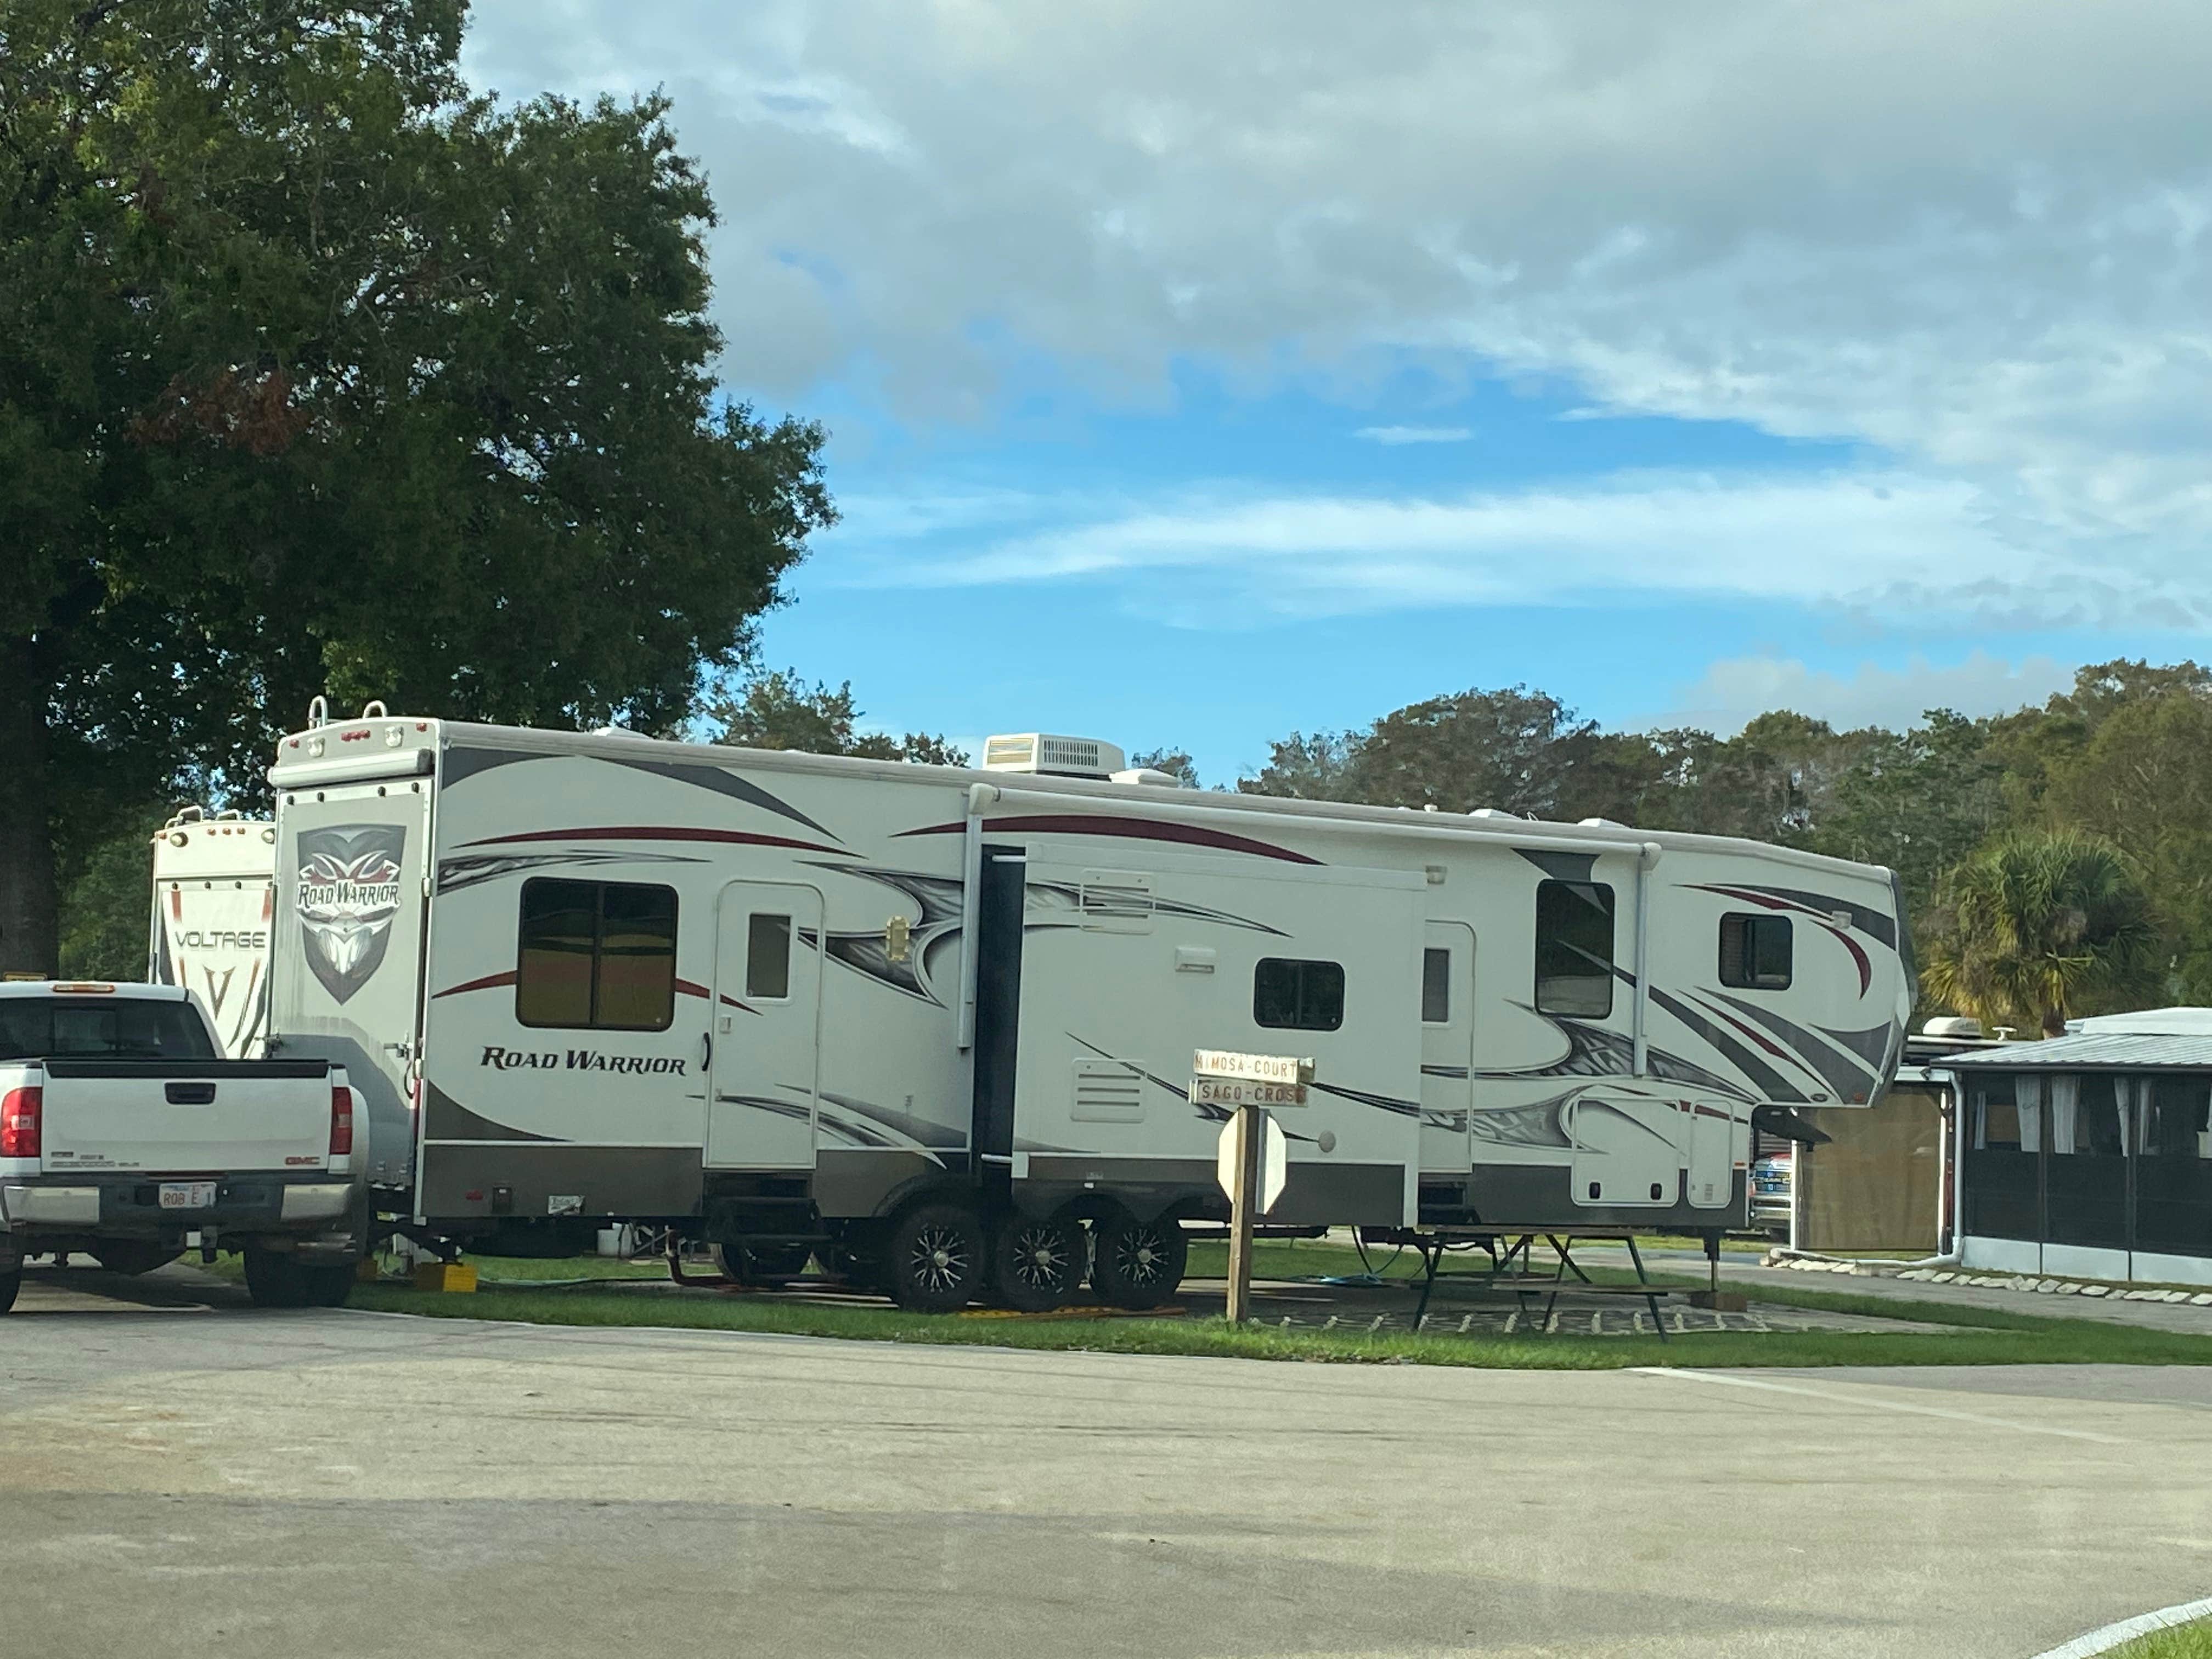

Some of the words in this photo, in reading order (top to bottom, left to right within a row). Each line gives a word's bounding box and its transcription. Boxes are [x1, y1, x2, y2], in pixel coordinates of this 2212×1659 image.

[298, 884, 334, 909] ROAD
[337, 882, 399, 906] WARRIOR
[174, 930, 267, 949] VOLTAGE
[481, 1046, 558, 1071] ROAD
[566, 1049, 687, 1076] WARRIOR
[286, 1156, 320, 1165] GMC
